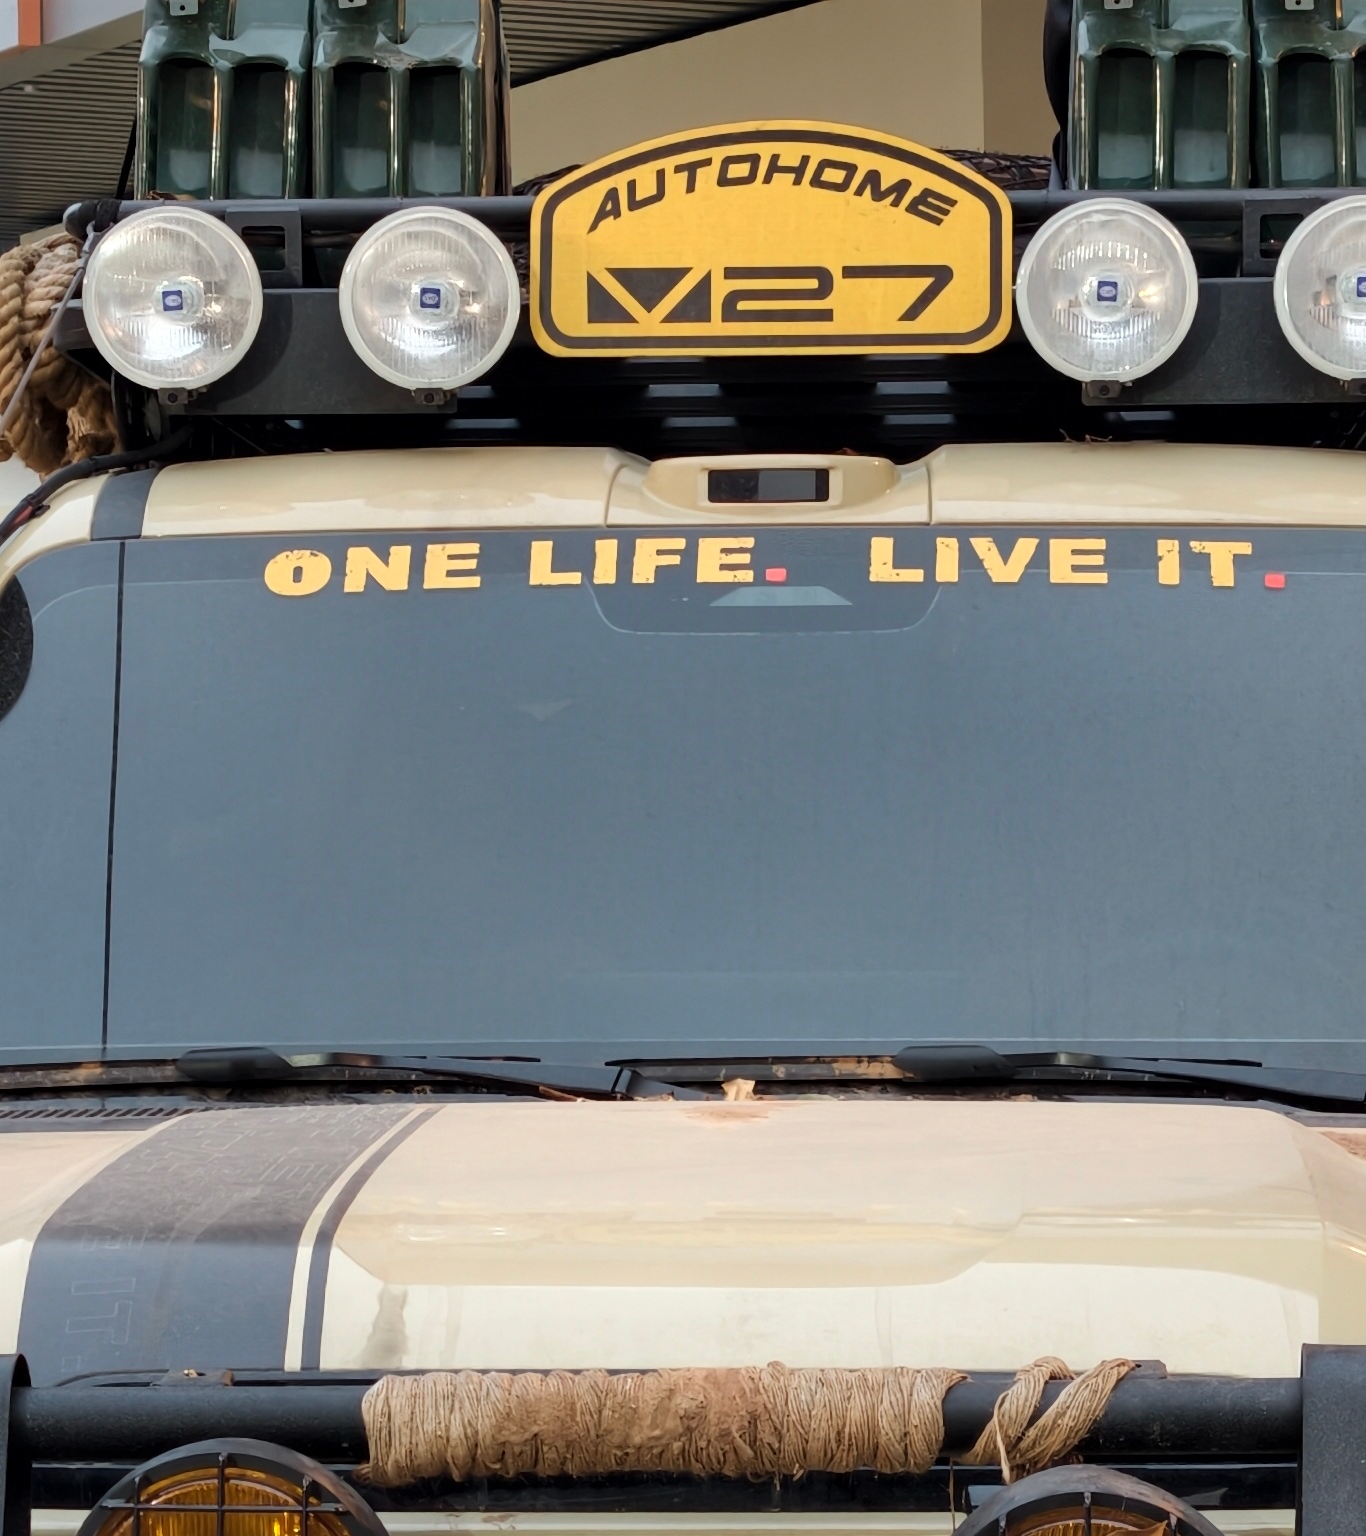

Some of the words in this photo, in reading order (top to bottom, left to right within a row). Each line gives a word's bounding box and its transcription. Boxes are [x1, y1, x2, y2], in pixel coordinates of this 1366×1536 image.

[587, 153, 958, 234] AUTOHOME
[587, 265, 954, 323] M27
[264, 542, 480, 596] ONE
[531, 537, 789, 583] LIFE.
[870, 537, 1106, 582] LIVE
[1157, 539, 1285, 588] IT.
